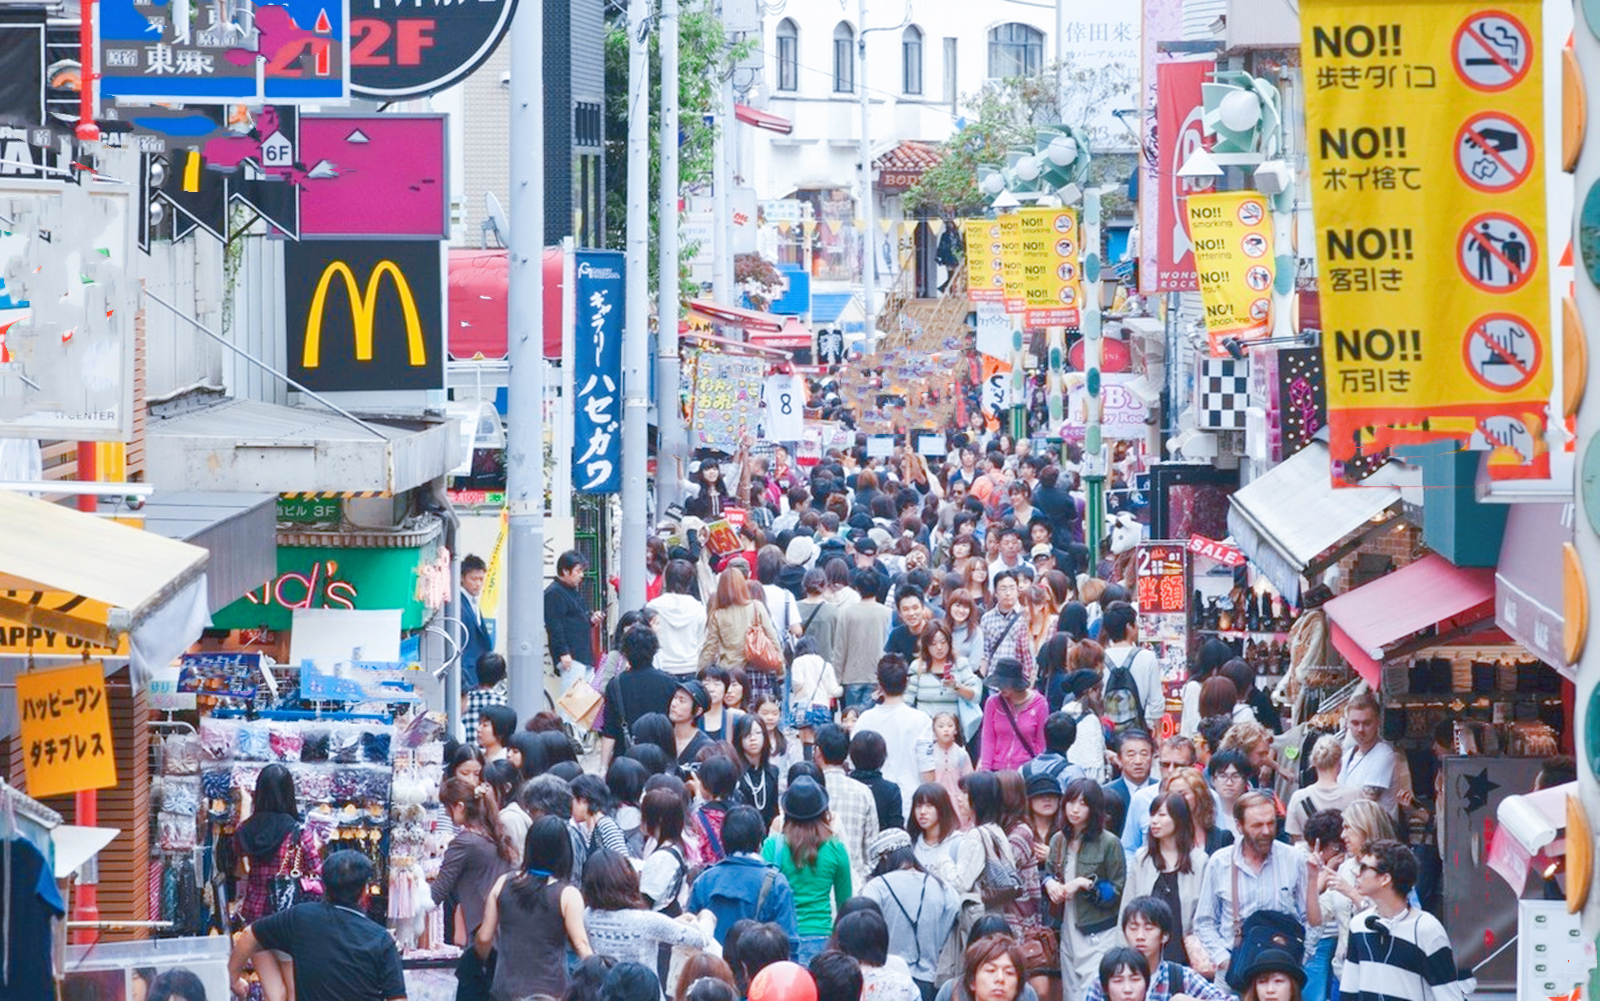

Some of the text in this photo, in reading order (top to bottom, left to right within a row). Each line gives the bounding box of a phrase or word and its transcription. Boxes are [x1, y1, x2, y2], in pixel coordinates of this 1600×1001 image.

[350, 19, 435, 65] 2F
[1066, 22, 1142, 42] 倖田來
[1313, 25, 1402, 58] NO!!
[1316, 64, 1436, 89] 歩きタバコ
[266, 145, 289, 161] 6F
[1319, 126, 1407, 160] NO!!
[1323, 166, 1422, 190] ポイ捨て
[1021, 218, 1043, 227] NO!!
[1191, 207, 1222, 219] NO!!
[1023, 242, 1045, 250] NO!!
[1195, 239, 1225, 251] NO!!
[1327, 229, 1414, 261] NO!!
[1025, 266, 1046, 274] NO!!
[1200, 272, 1230, 284] NO!!
[1330, 267, 1403, 292] 客引き
[1027, 290, 1048, 298] NO!!
[1206, 304, 1234, 317] NO!!
[1335, 329, 1422, 361] NO!!
[577, 290, 619, 490] ギャラリー ハセガワ
[1338, 368, 1411, 393] 万引き
[780, 393, 792, 415] 8
[313, 505, 336, 517] 3F
[1190, 538, 1238, 564] SALE
[1138, 576, 1185, 609] 半額
[22, 685, 102, 722] ハッピーワン
